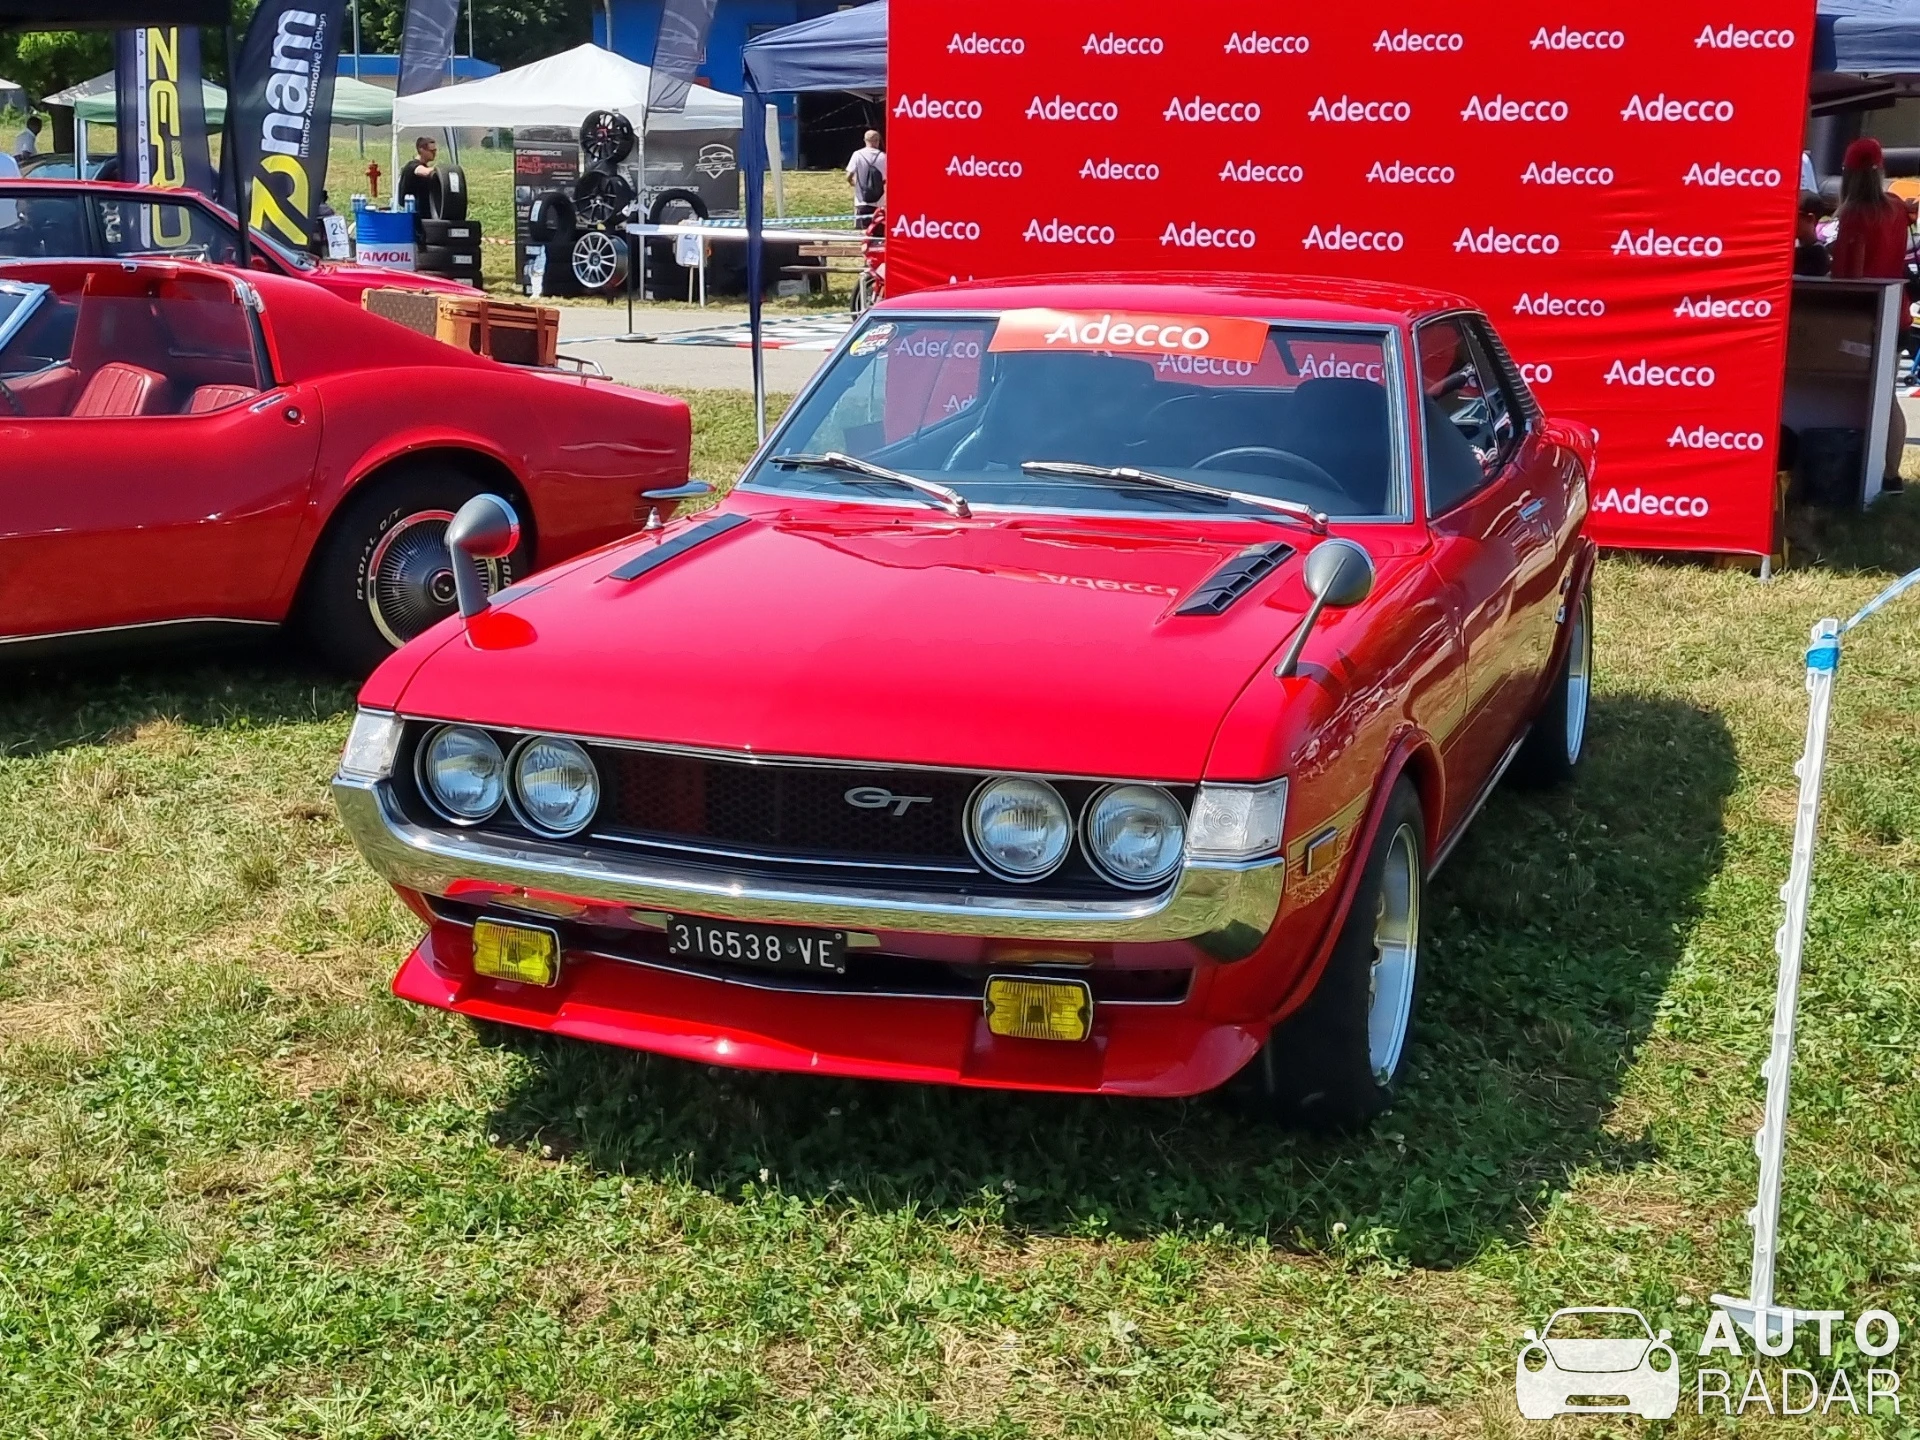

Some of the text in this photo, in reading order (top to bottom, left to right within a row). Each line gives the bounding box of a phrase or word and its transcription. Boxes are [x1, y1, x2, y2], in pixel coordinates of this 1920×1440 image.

[946, 31, 1025, 55] Adecco
[1081, 32, 1164, 55] Adecco
[1223, 30, 1310, 54] Adecco
[1372, 28, 1463, 52] Adecco
[1529, 25, 1625, 50] Adecco
[1694, 23, 1795, 49] Adecco
[299, 118, 311, 158] Interior
[308, 50, 323, 117] Automotive
[892, 93, 983, 119] Adecco
[1024, 94, 1118, 121] Adecco
[1162, 95, 1261, 122] Adecco
[1307, 94, 1411, 122] Adecco
[1460, 94, 1569, 122] Adecco
[1620, 93, 1734, 122] Adecco
[140, 120, 148, 209] RACIG
[945, 155, 1023, 178] Adecco
[1078, 157, 1160, 180] Adecco
[1218, 159, 1303, 183] Adecco
[1365, 160, 1455, 184] Adecco
[1520, 160, 1614, 185] Adecco
[1682, 161, 1781, 187] Adecco
[890, 213, 980, 240] Adecco
[1022, 217, 1115, 245] Adecco
[1159, 221, 1256, 248] Adecco
[1301, 224, 1404, 252] Adecco
[1452, 226, 1560, 254] Adecco
[1610, 228, 1723, 257] Adecco
[358, 251, 412, 263] TAMOIL
[1512, 292, 1605, 317] Adecco
[1673, 295, 1772, 318] Adecco
[1045, 313, 1210, 350] Adecco
[1299, 352, 1386, 382] Adecc
[1603, 358, 1715, 387] Adecco
[1666, 424, 1764, 451] Adecco
[1597, 487, 1709, 517] Adecco
[844, 786, 933, 816] GT
[675, 924, 836, 968] 316538 VE
